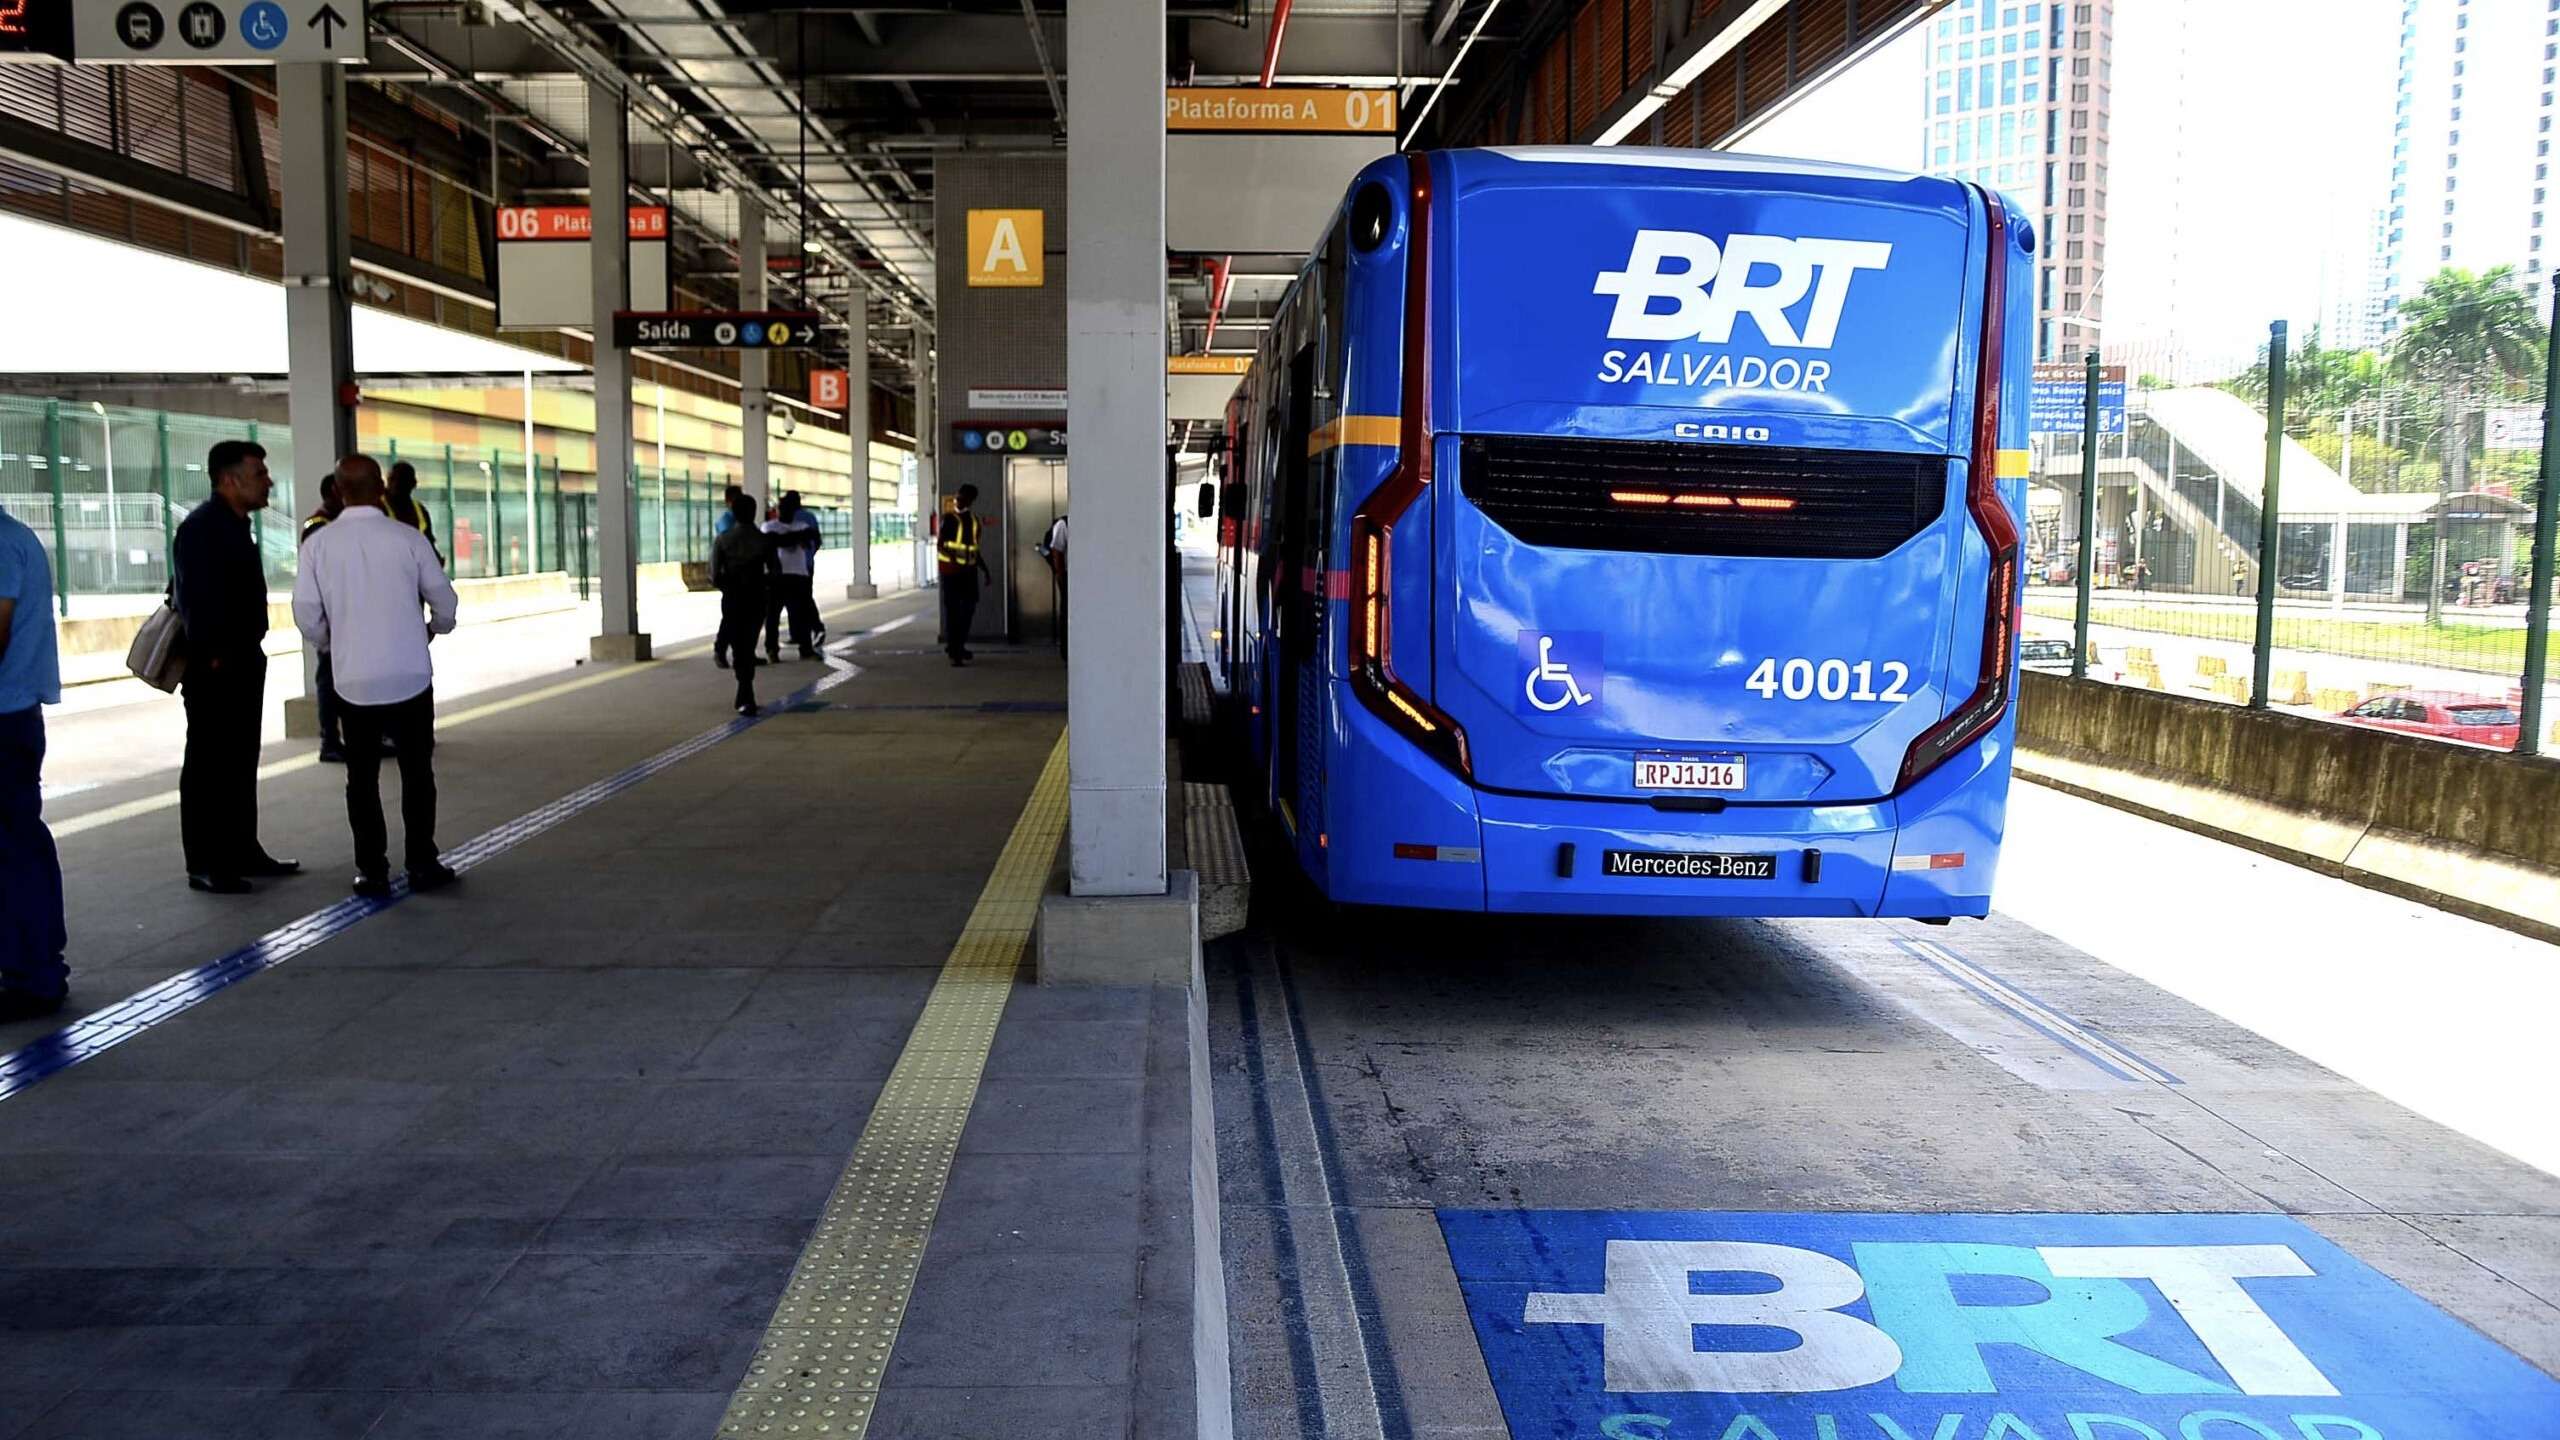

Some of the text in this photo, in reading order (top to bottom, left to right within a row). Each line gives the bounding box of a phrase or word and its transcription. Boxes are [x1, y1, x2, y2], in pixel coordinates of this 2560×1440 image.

[1167, 90, 1394, 130] Plataforma A 01
[501, 207, 540, 238] 06
[983, 217, 1028, 272] A
[1593, 229, 1893, 350] BRT
[638, 320, 691, 340] Saída
[820, 374, 839, 402] B
[1598, 350, 1832, 393] SALVADOR
[1745, 657, 1910, 703] 40012
[1646, 764, 1733, 786] RPJ1J16
[1611, 852, 1769, 877] Mercedes-Benz
[1523, 1239, 2342, 1396] BRT
